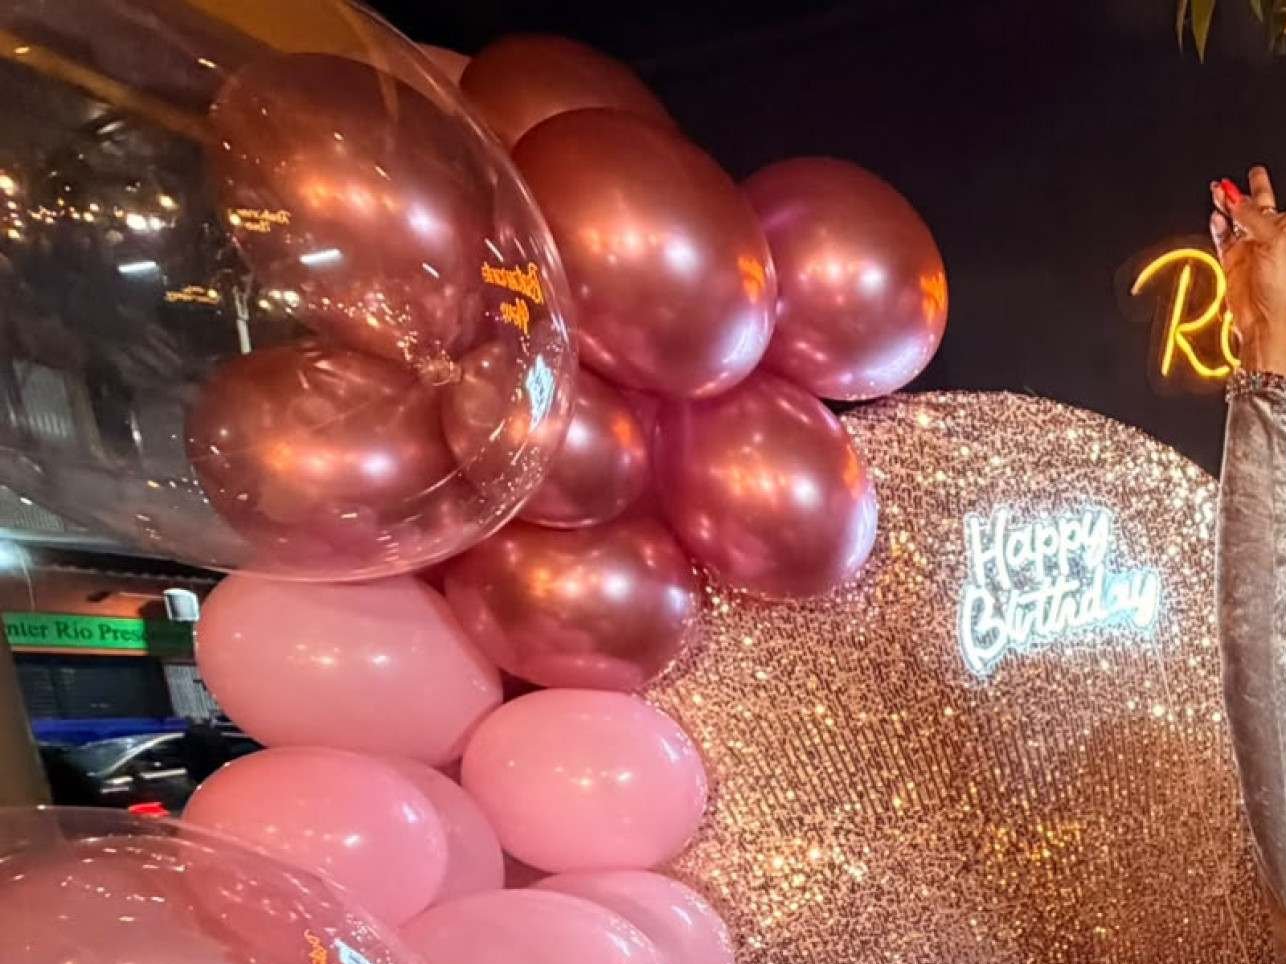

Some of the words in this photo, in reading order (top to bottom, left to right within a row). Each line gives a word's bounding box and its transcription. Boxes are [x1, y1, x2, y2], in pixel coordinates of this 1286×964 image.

[967, 505, 1109, 590] Happy
[56, 620, 92, 640] Rio
[959, 563, 1159, 672] Birthday
